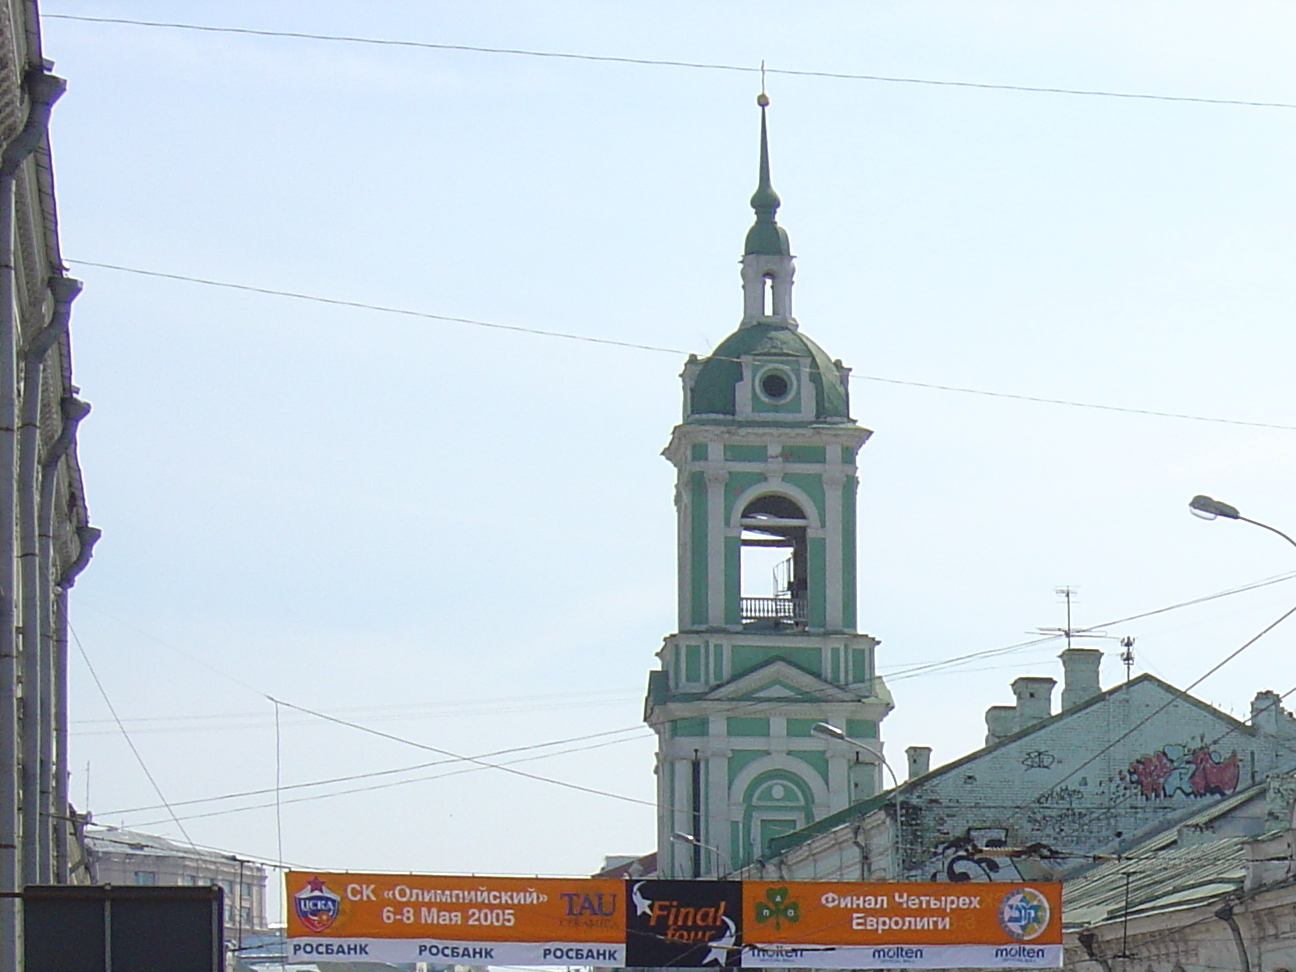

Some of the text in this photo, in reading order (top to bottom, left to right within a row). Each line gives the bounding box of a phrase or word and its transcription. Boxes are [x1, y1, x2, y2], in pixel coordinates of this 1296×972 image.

[346, 884, 548, 905] СК «Олимпийский»
[821, 892, 980, 911] Финал Четырех
[301, 899, 334, 912] ЦСКА
[560, 893, 617, 916] TAU
[382, 907, 515, 926] 6-8 Мая 2005
[650, 901, 726, 926] Final
[852, 914, 950, 933] Евролиги
[665, 925, 715, 943] four
[293, 943, 369, 955] РОСБАНК
[418, 945, 494, 959] РОСБАНК
[543, 948, 617, 961] РОСБАНК
[751, 945, 803, 958] molten
[872, 947, 923, 959] molten
[995, 946, 1045, 958] molten
